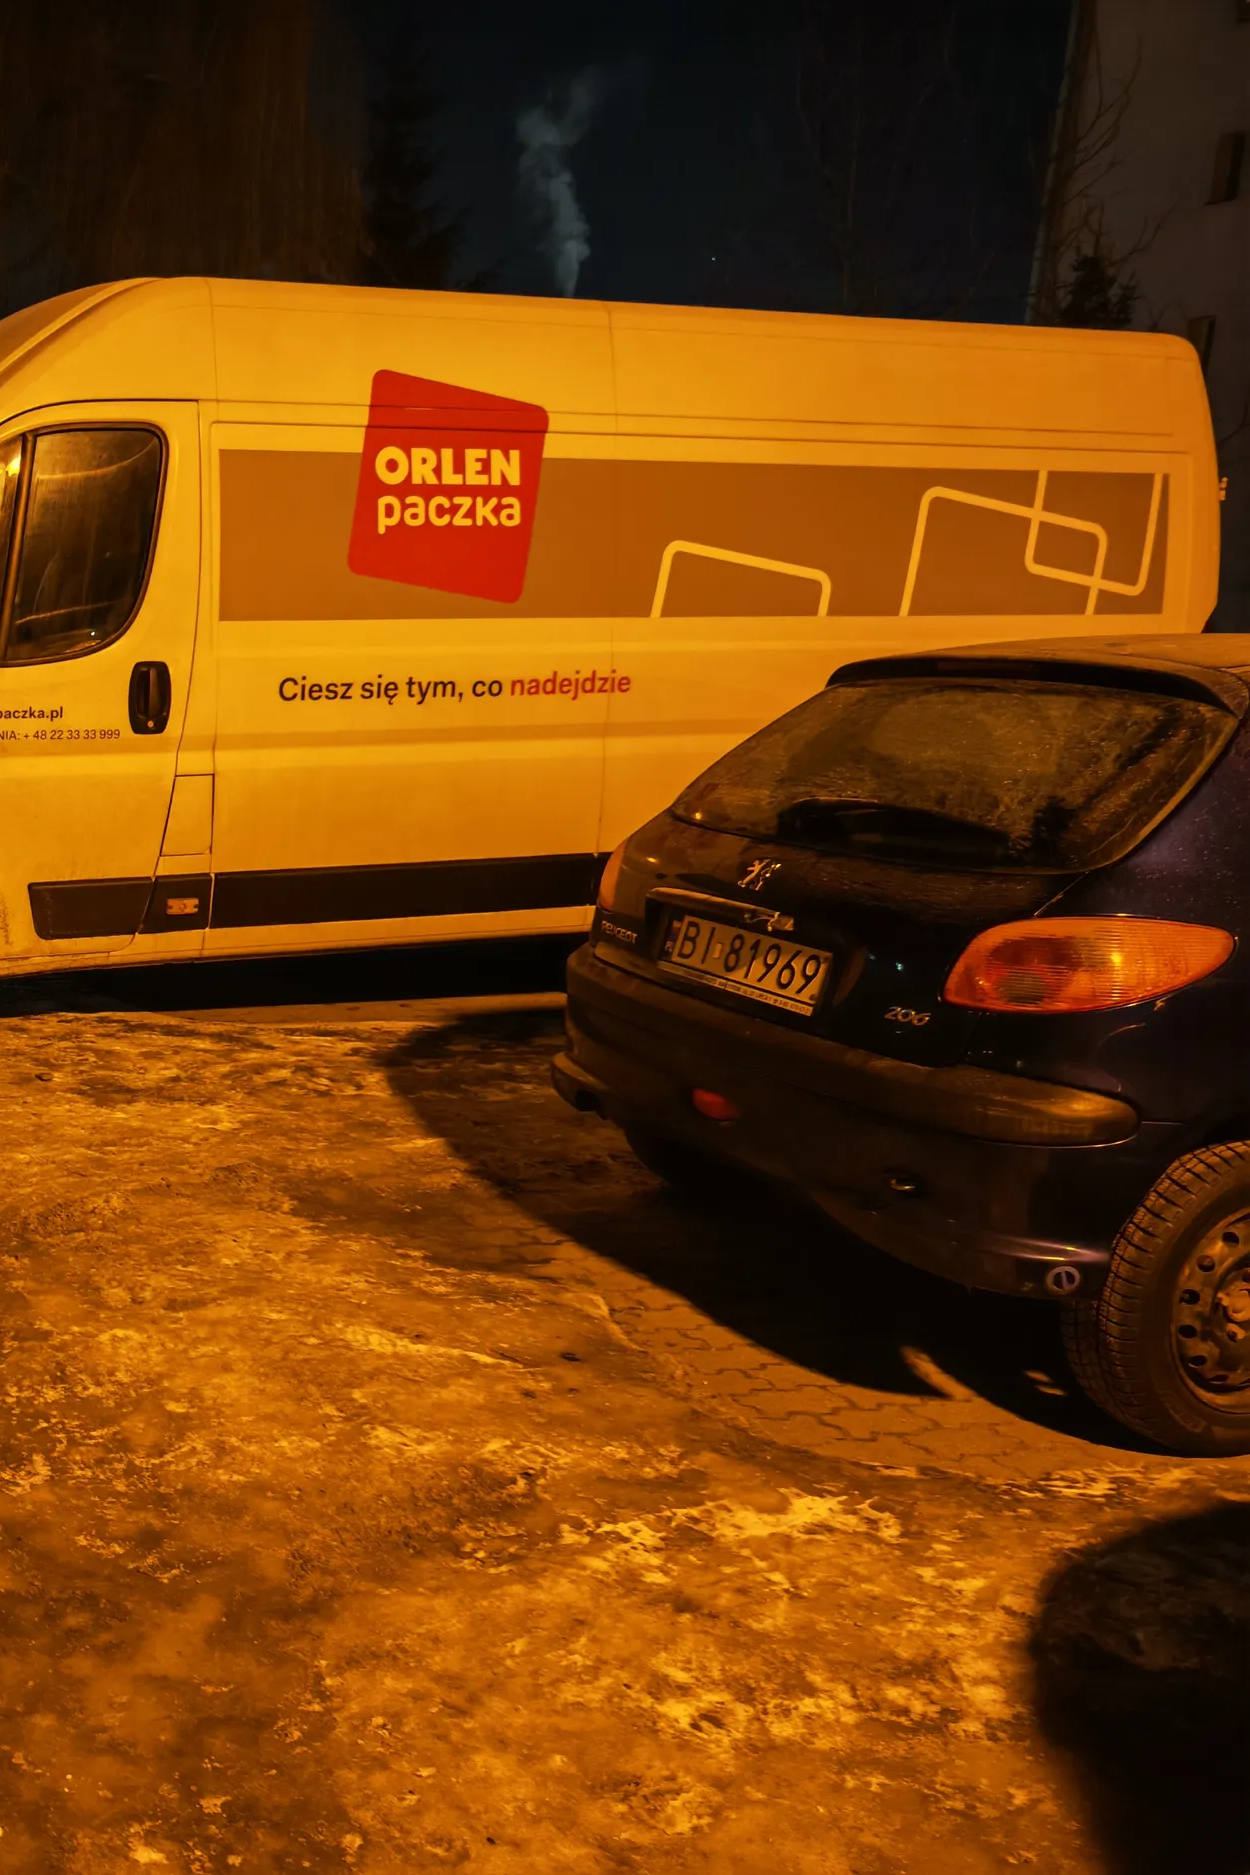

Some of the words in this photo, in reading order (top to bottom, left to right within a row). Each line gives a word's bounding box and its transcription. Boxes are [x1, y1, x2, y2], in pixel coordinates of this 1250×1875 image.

[375, 446, 520, 485] ORLEN
[378, 495, 521, 535] paczka
[279, 675, 353, 702] Ciesz
[360, 674, 399, 706] się
[406, 676, 464, 706] tym,
[471, 679, 503, 698] co
[510, 669, 632, 701] nadejdzie
[33, 730, 47, 740] 48
[50, 730, 64, 740] 22
[66, 729, 80, 740] 33
[83, 729, 97, 740] 33
[99, 729, 121, 740] 999
[677, 921, 716, 964] BI
[723, 933, 822, 995] 81969
